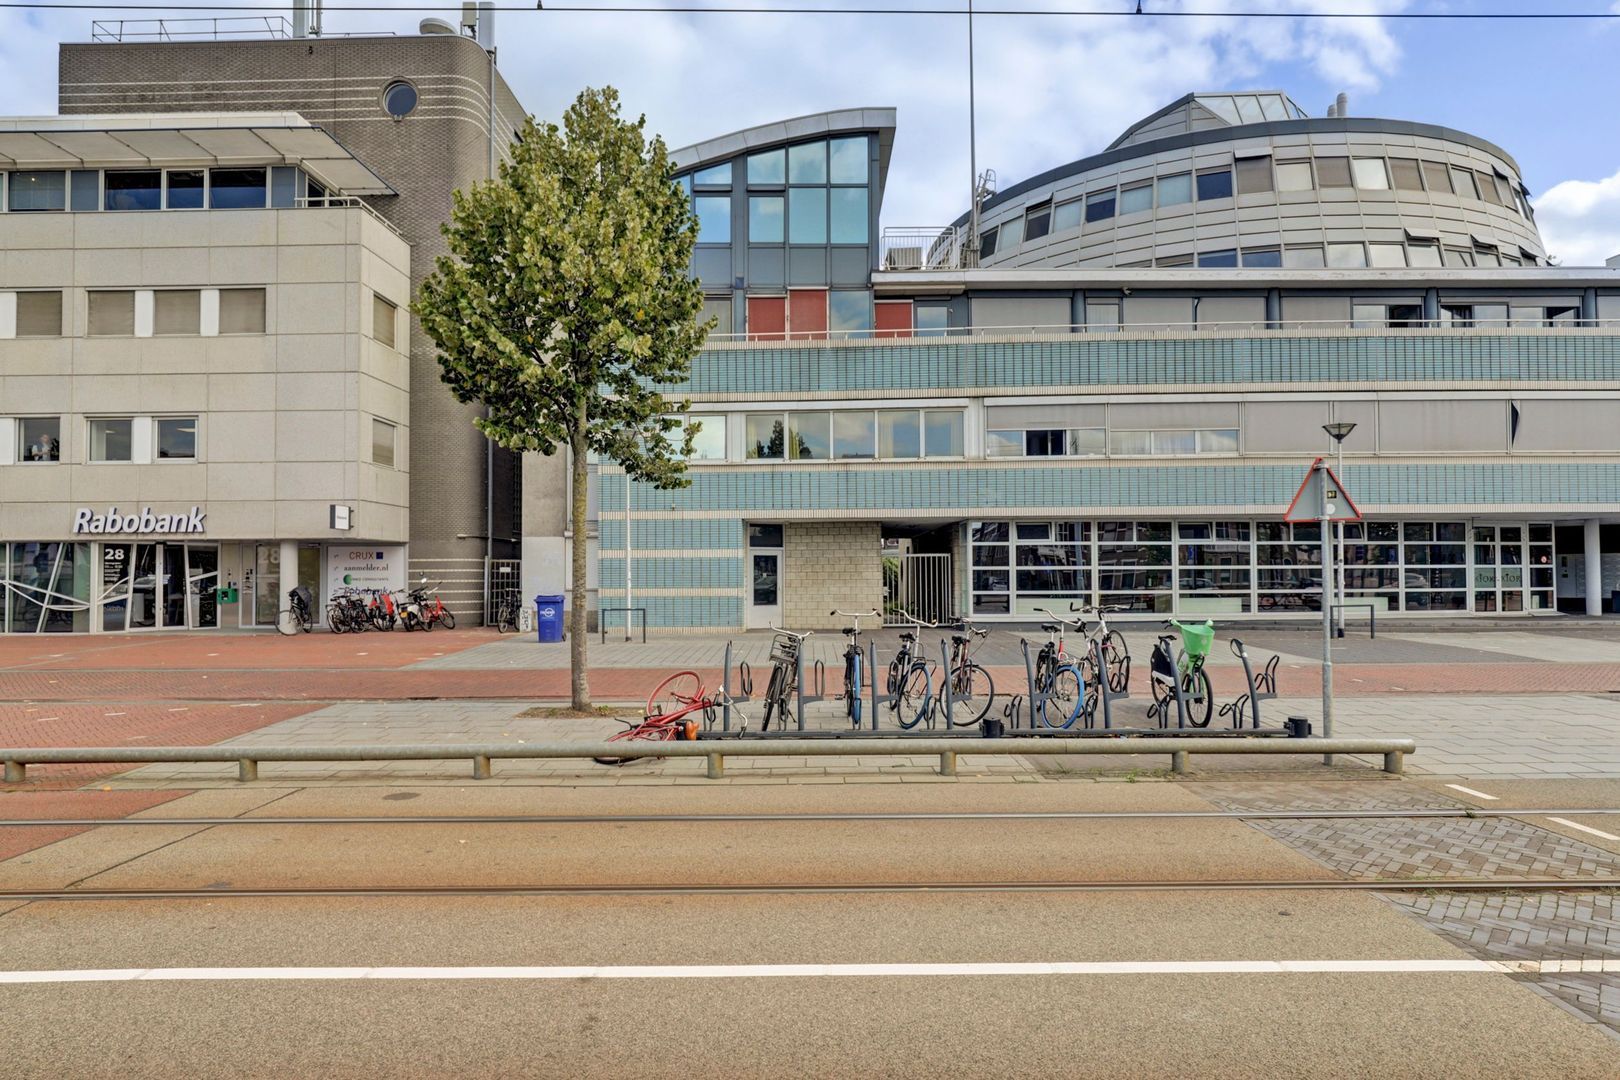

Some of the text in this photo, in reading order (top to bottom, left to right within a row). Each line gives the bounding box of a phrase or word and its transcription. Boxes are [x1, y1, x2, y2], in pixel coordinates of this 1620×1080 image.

[73, 506, 206, 533] Rabobank
[104, 549, 125, 560] 28
[349, 552, 374, 560] CRUX
